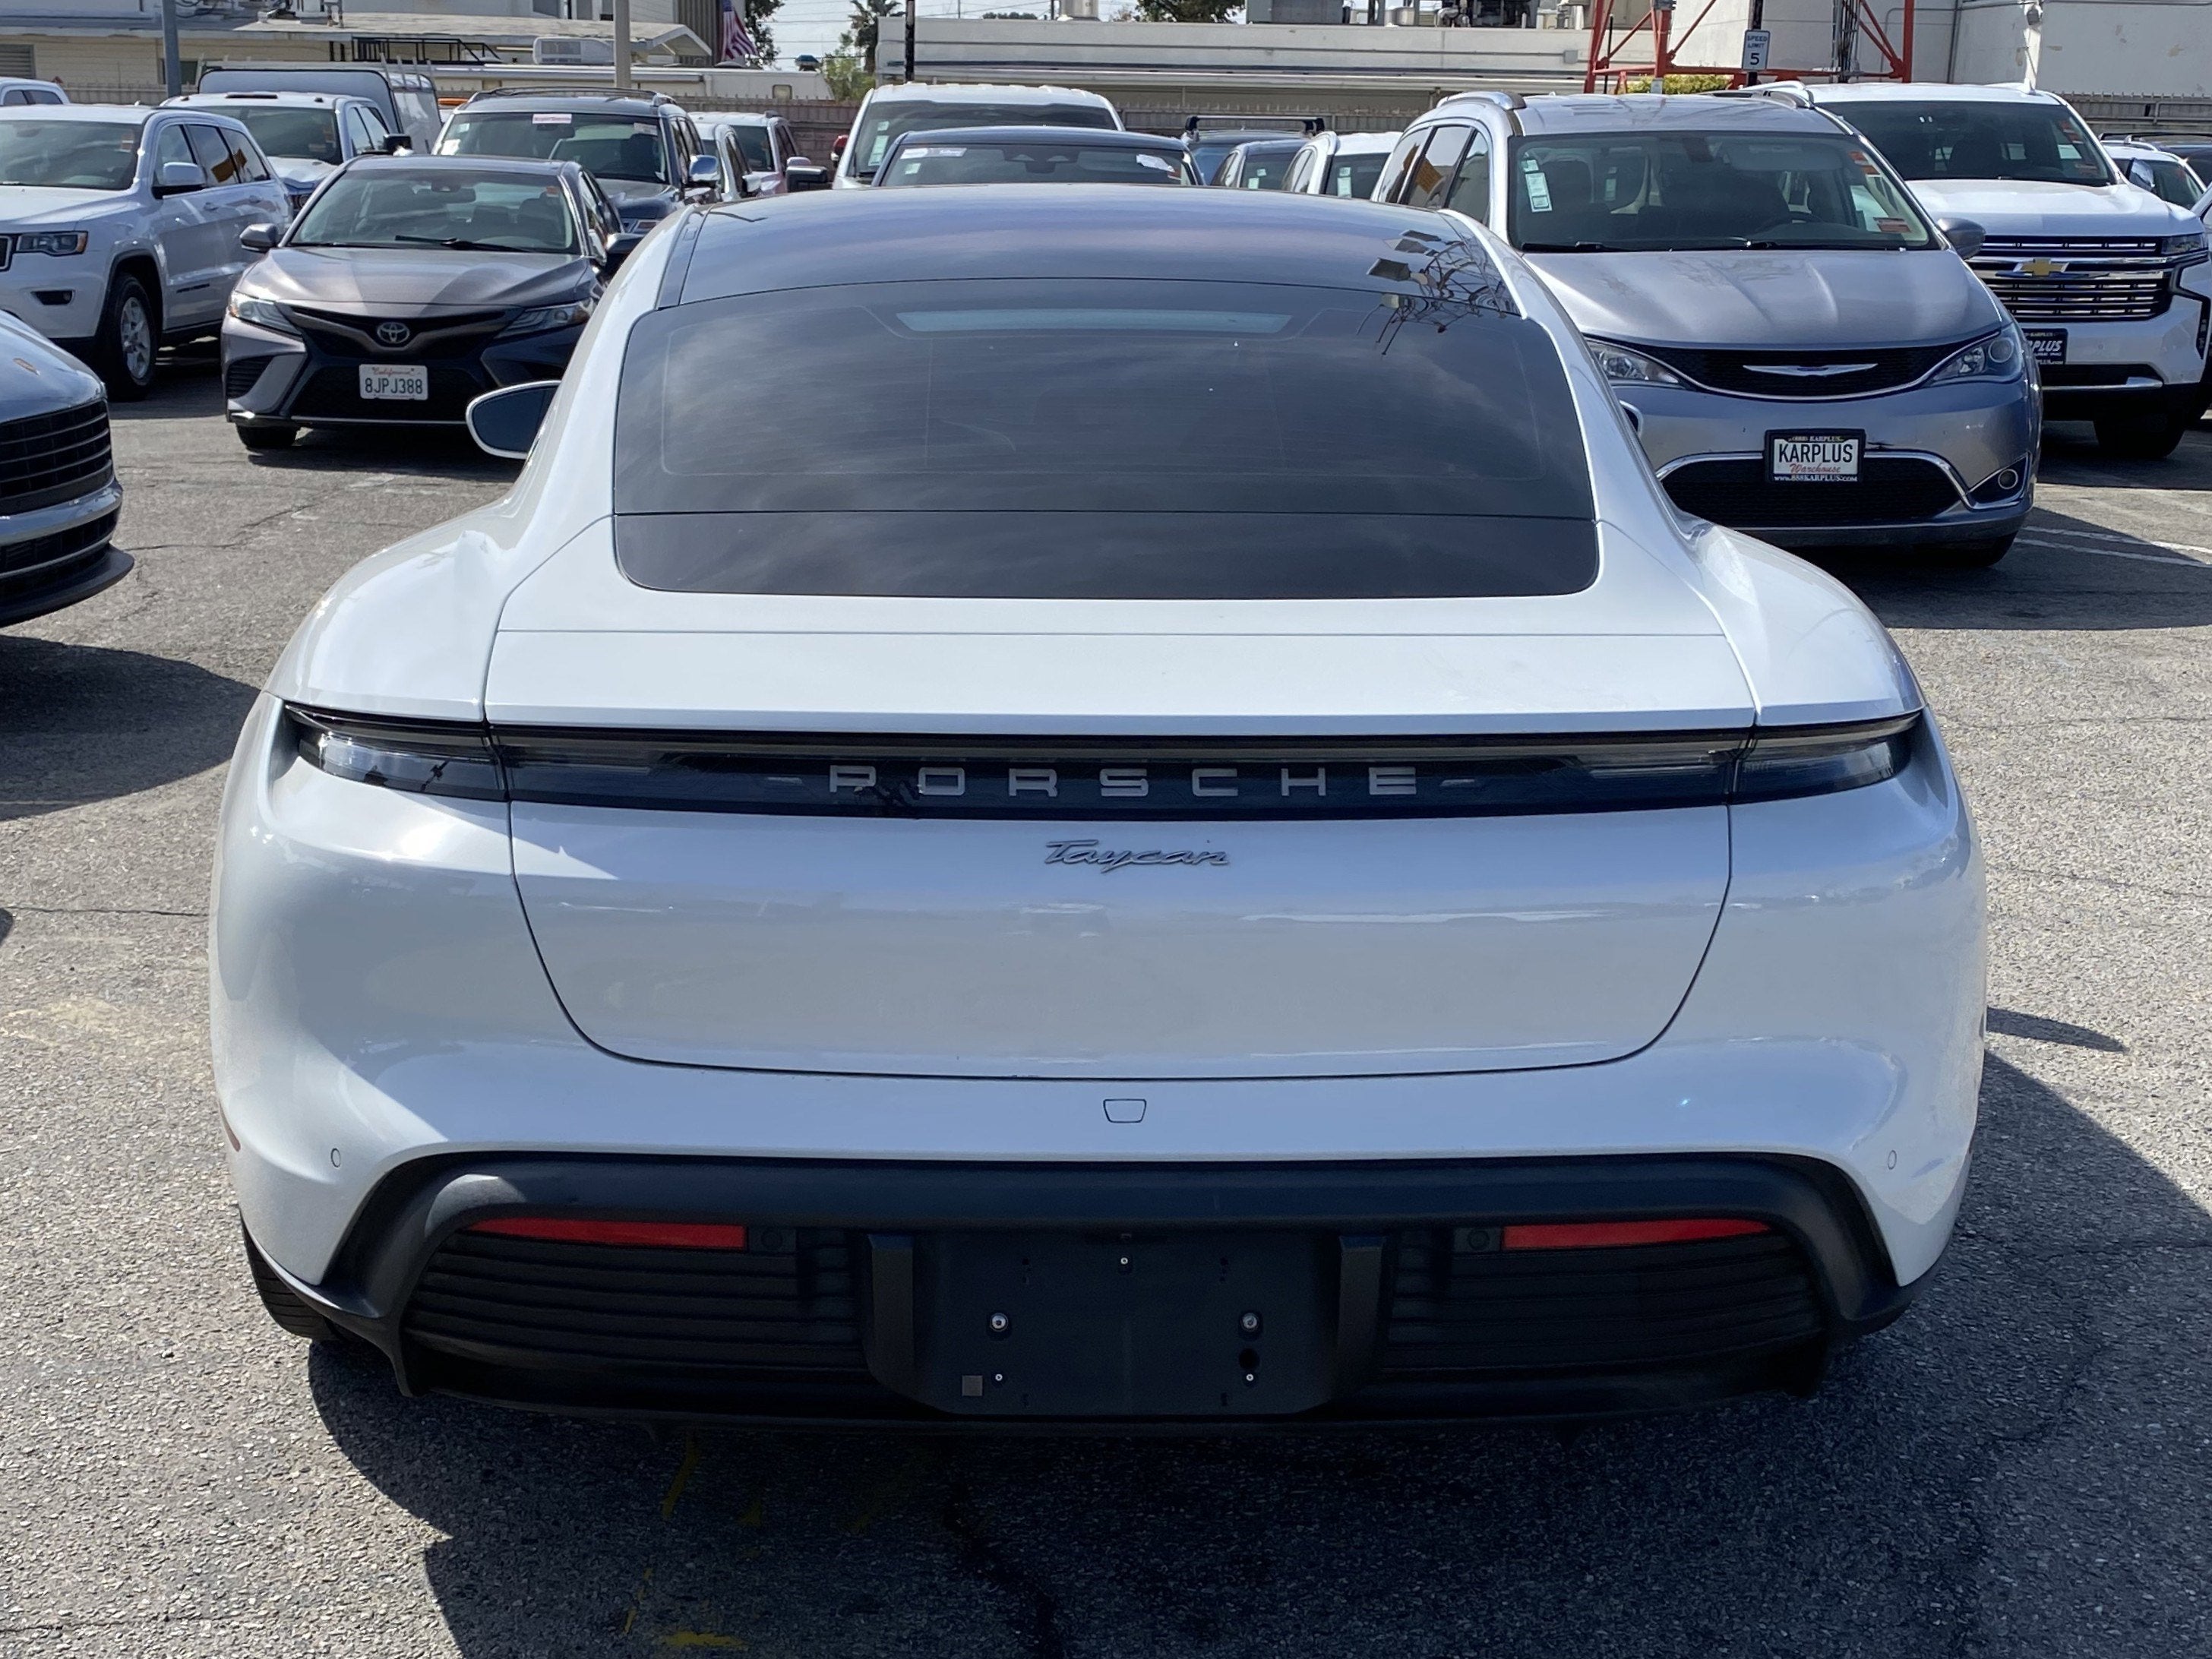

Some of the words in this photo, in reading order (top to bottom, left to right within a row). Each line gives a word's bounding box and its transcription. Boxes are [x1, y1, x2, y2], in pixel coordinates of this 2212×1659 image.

[1750, 52, 1760, 65] 5
[2028, 340, 2063, 352] PLUS
[365, 378, 423, 394] 8JPJ388
[1778, 444, 1853, 463] KARPLUS
[1790, 463, 1841, 474] Warehouse
[830, 765, 1417, 798] PORSCHE
[1044, 839, 1230, 874] Taycan
